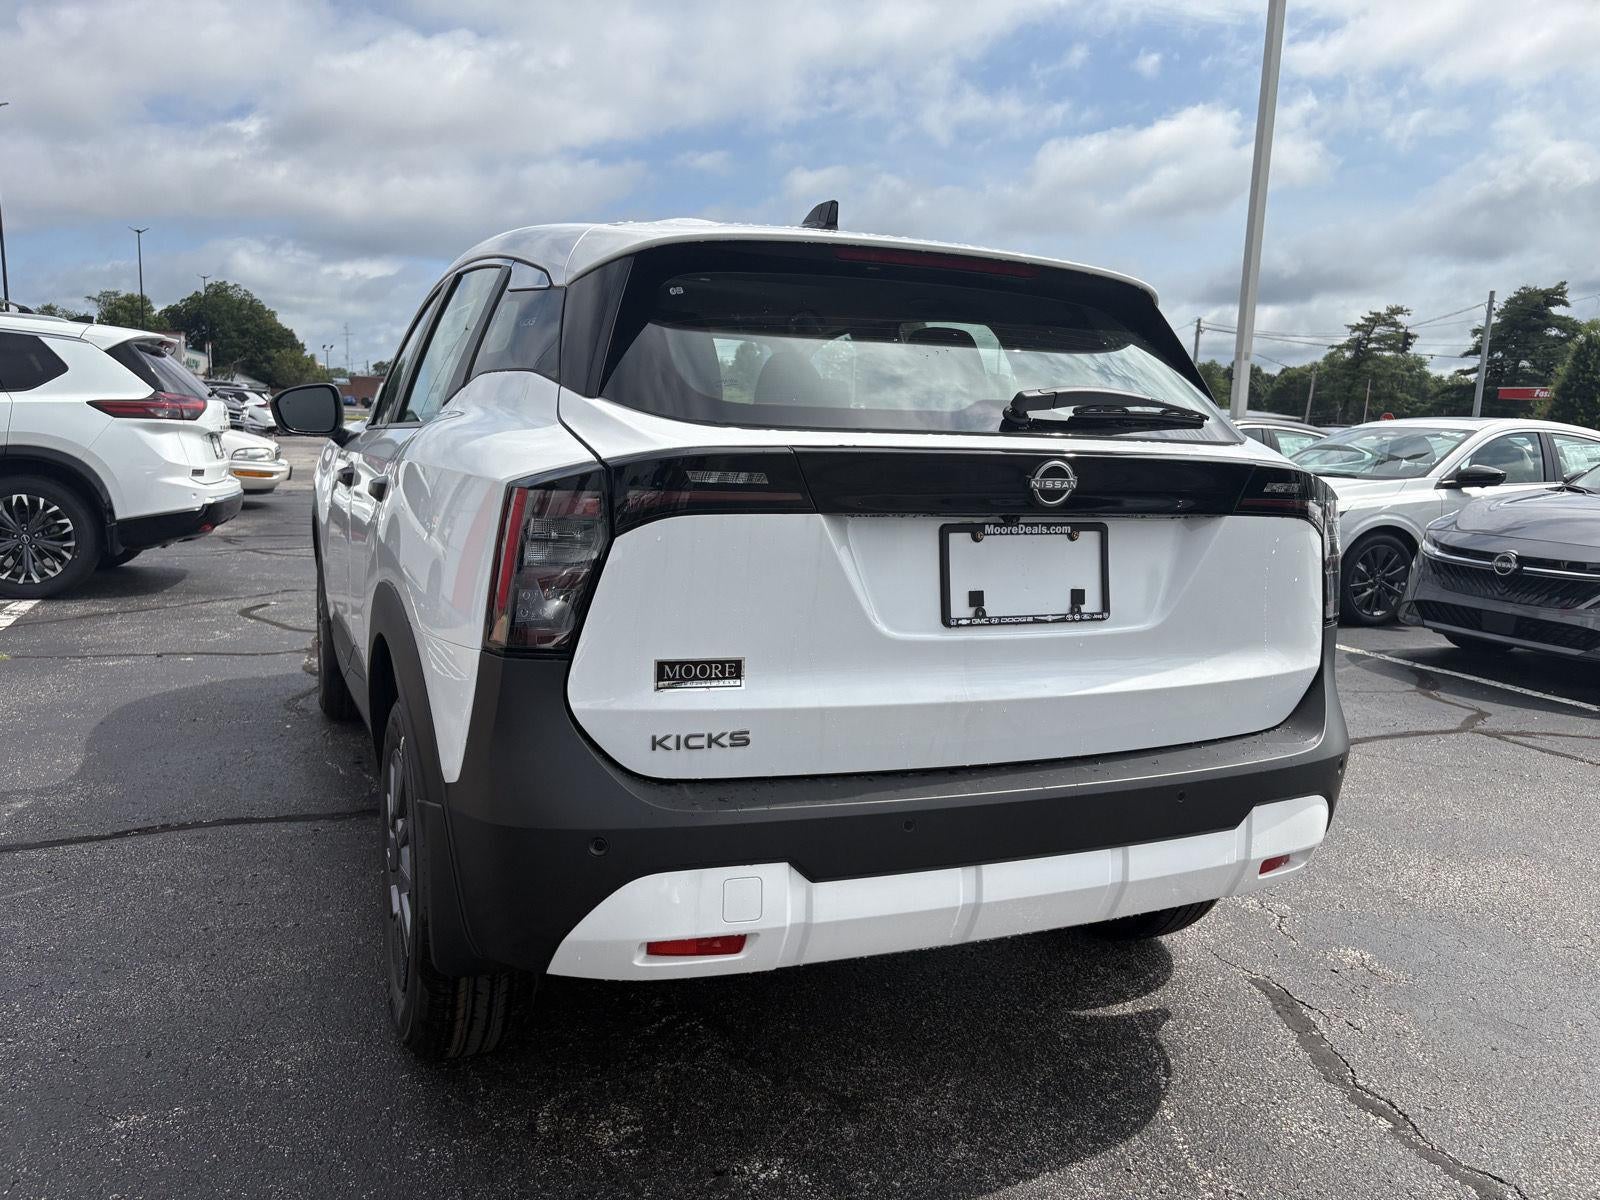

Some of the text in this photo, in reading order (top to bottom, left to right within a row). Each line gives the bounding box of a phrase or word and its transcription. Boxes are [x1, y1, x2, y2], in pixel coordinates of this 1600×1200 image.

[1031, 480, 1077, 488] NISSAN
[984, 524, 1071, 534] MooreDeals.com
[664, 663, 737, 679] MOORE
[651, 730, 750, 751] KICKS
